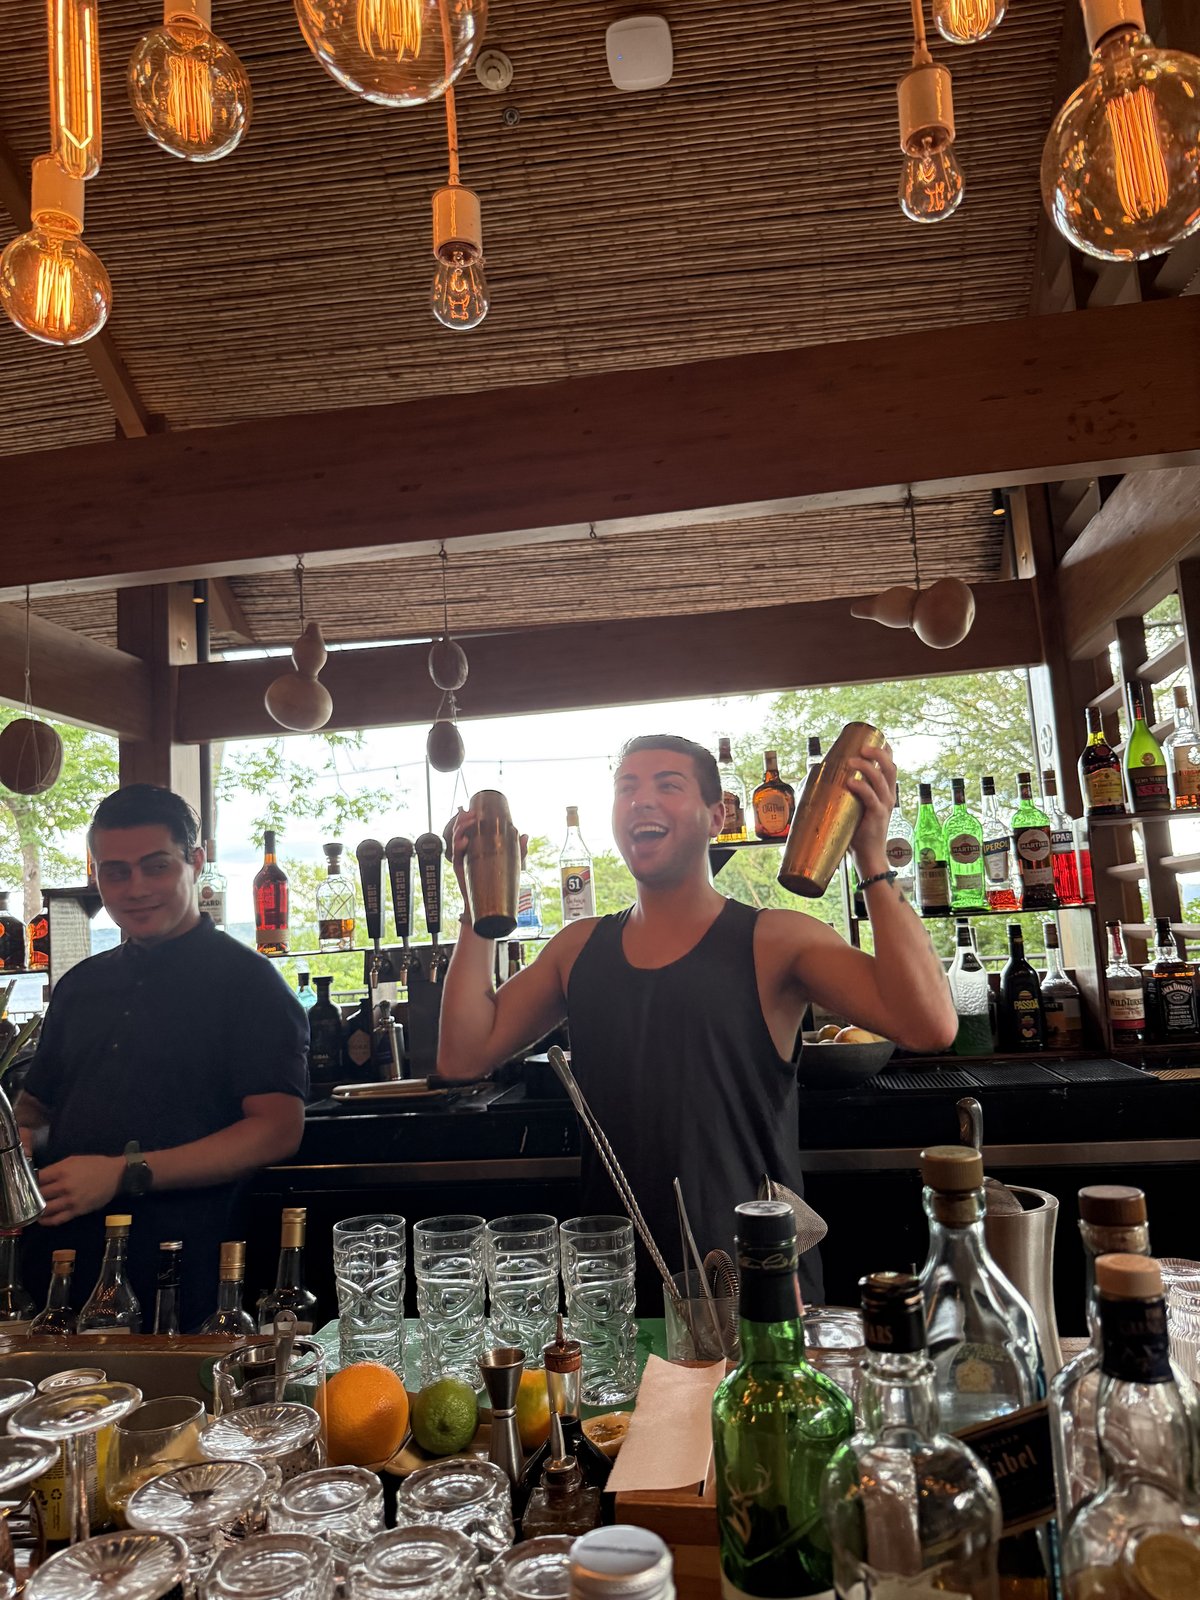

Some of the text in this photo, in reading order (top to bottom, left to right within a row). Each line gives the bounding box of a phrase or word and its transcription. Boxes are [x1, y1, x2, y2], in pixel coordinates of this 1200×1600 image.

[1050, 832, 1073, 843] MPARI
[952, 845, 980, 854] MARTINI
[1021, 840, 1048, 850] MARTINI
[568, 878, 581, 890] 51
[198, 899, 222, 907] CARDI
[1161, 982, 1193, 995] JACK DANIEL'S
[985, 1445, 1038, 1479] abel
